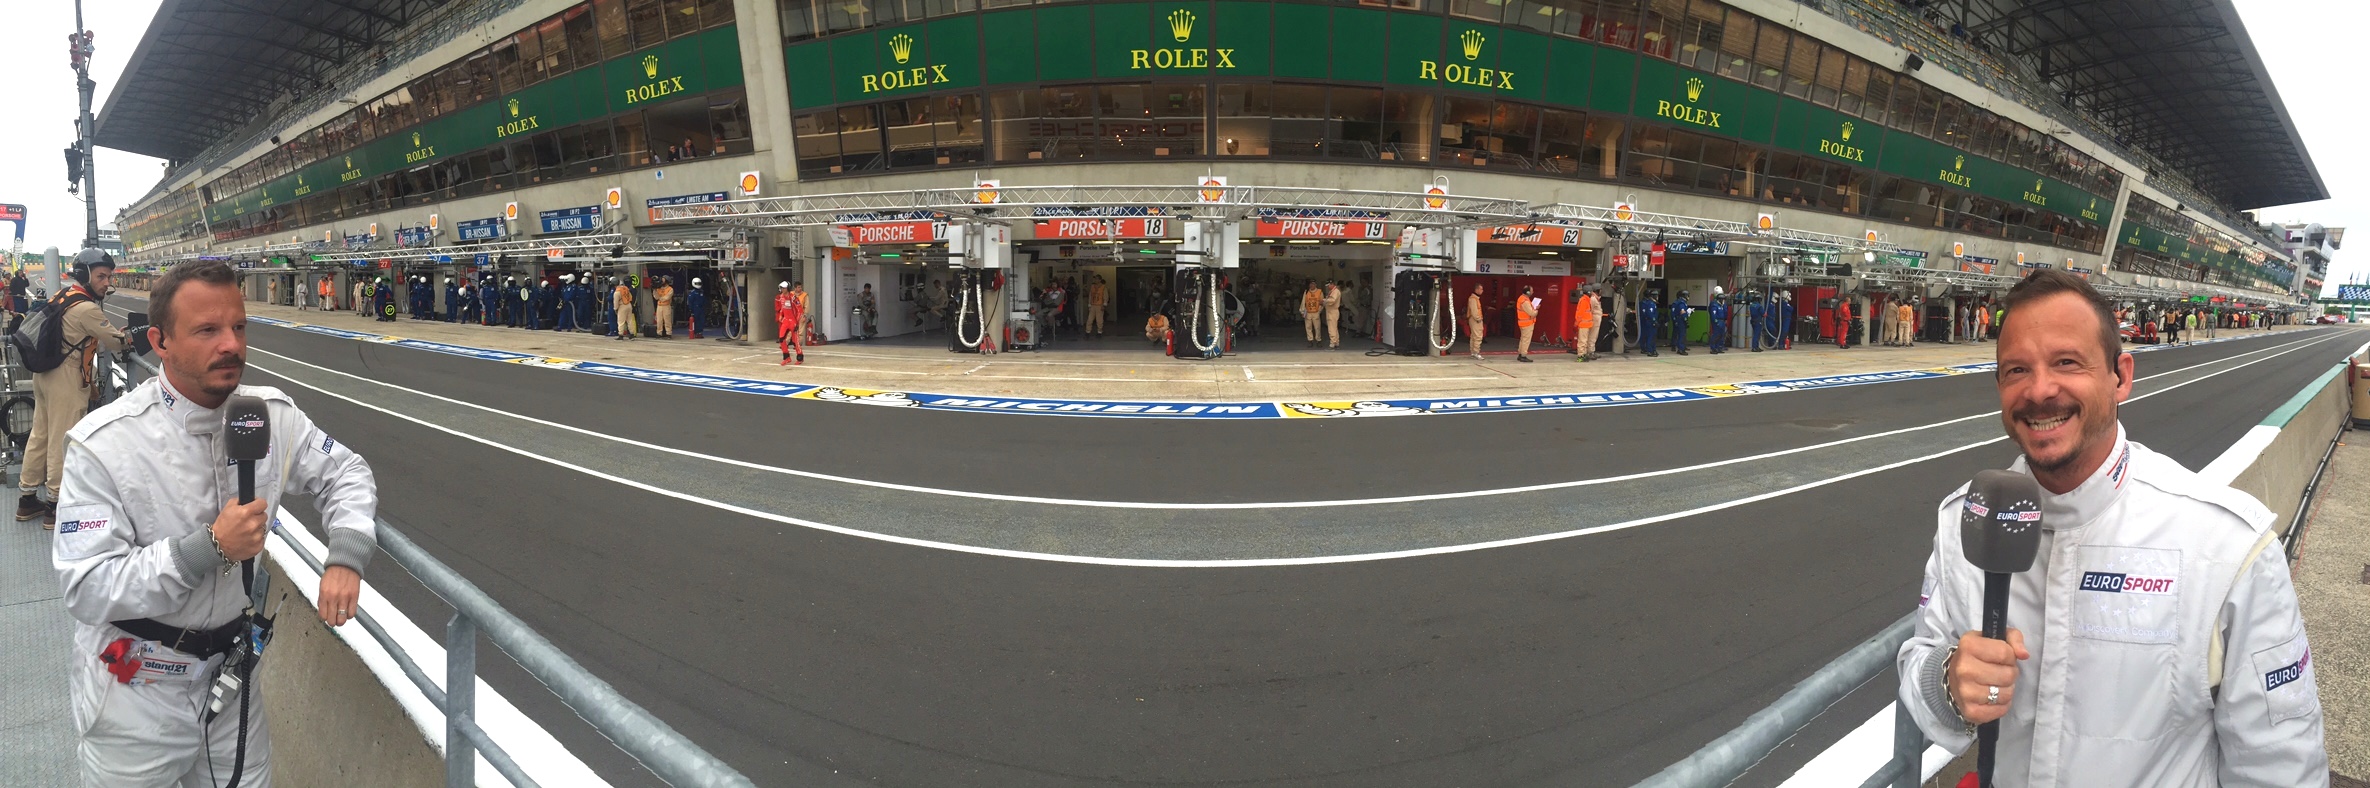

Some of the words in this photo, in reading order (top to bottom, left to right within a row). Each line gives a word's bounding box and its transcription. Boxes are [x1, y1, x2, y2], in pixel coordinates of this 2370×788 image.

[1131, 48, 1235, 70] ROLEX
[862, 64, 949, 93] ROLEX
[1419, 60, 1514, 90] ROLEX
[625, 76, 684, 104] ROLEX
[1657, 100, 1721, 128] ROLEX
[496, 115, 538, 138] ROLEX
[406, 145, 435, 163] ROLEX
[1819, 139, 1864, 162] ROLEX
[341, 168, 361, 182] ROLEX
[1939, 169, 1971, 188] ROLEX
[295, 185, 311, 196] ROLEX
[2023, 191, 2047, 206] ROLEX
[550, 217, 582, 231] BR-NISSAN
[592, 215, 600, 228] 37
[2081, 209, 2098, 221] ROLEX
[465, 227, 492, 239] BR-NISSAN
[860, 225, 914, 242] PORSCHE
[933, 222, 948, 239] 17
[1059, 219, 1125, 237] PORSCE
[1146, 219, 1161, 234] 18
[1281, 220, 1345, 236] PORSCHE
[1366, 222, 1383, 237] 19
[1563, 229, 1578, 244] 62
[476, 256, 485, 265] 37
[1480, 263, 1490, 273] 62
[1619, 257, 1627, 265] 62
[1778, 369, 1927, 389] MICHELIN
[932, 398, 1262, 415] MICHELIN
[1430, 389, 1684, 410] MICHELIN
[231, 420, 264, 428] EUROSPORT
[1996, 511, 2041, 522] EUROSPORT
[60, 519, 108, 533] EUROSPORT
[2082, 574, 2174, 593] EUROSPORT
[2086, 622, 2128, 635] Discovery
[2131, 625, 2175, 639] Company
[144, 660, 187, 674] stand21
